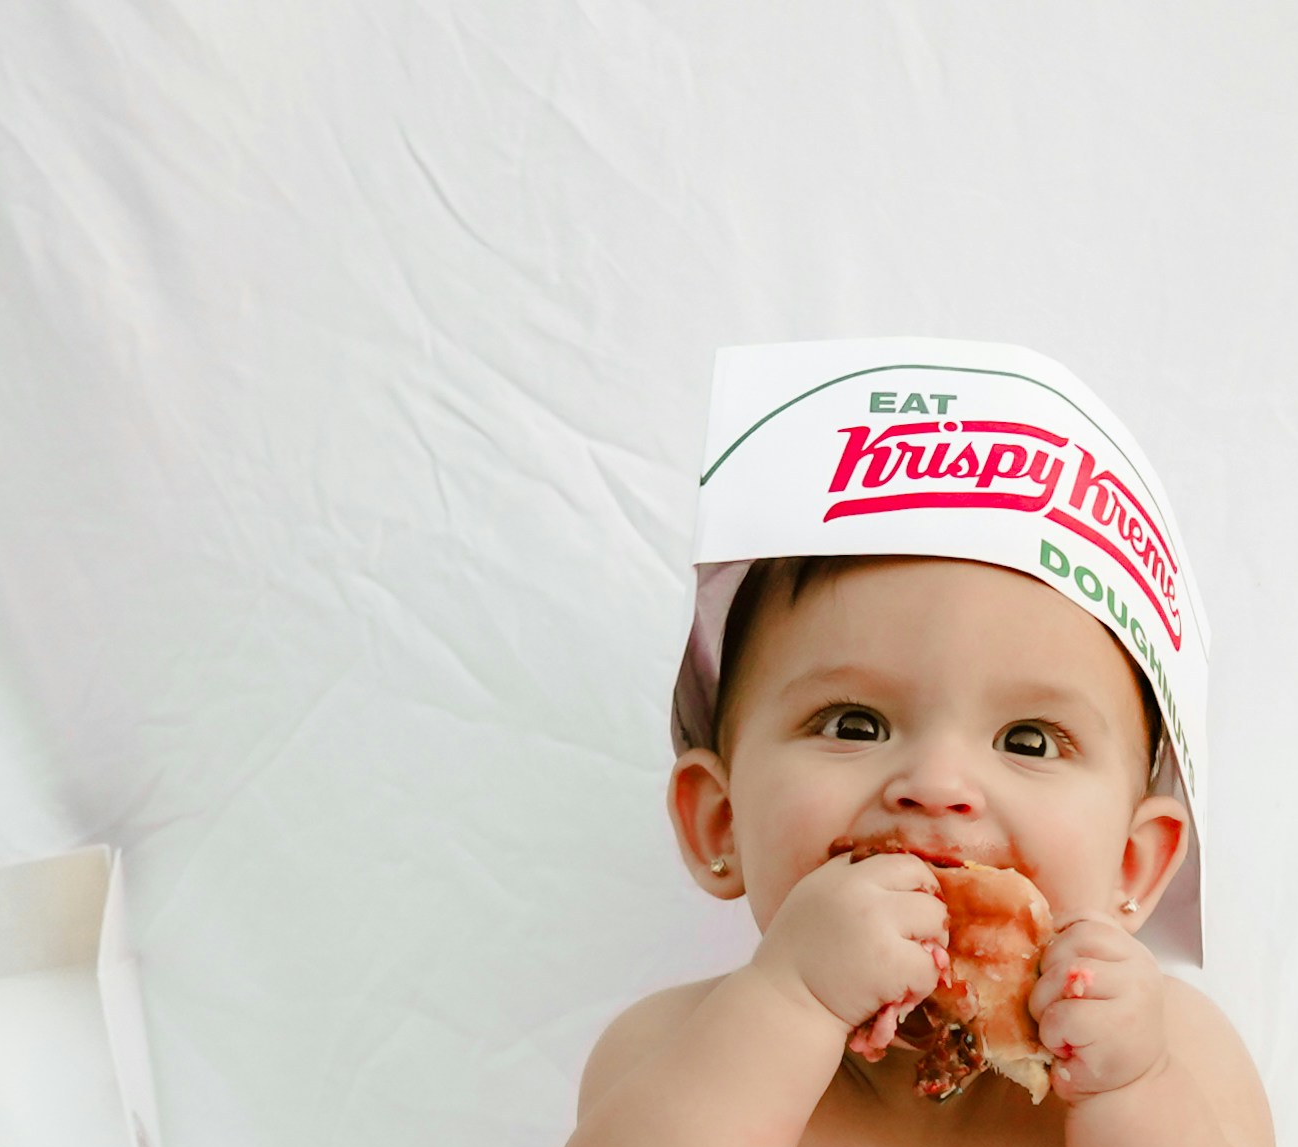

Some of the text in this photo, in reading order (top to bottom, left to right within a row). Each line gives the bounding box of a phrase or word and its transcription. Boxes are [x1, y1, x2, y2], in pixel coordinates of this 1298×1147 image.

[869, 391, 957, 415] EAT
[823, 419, 1183, 652] Krispy Kreme
